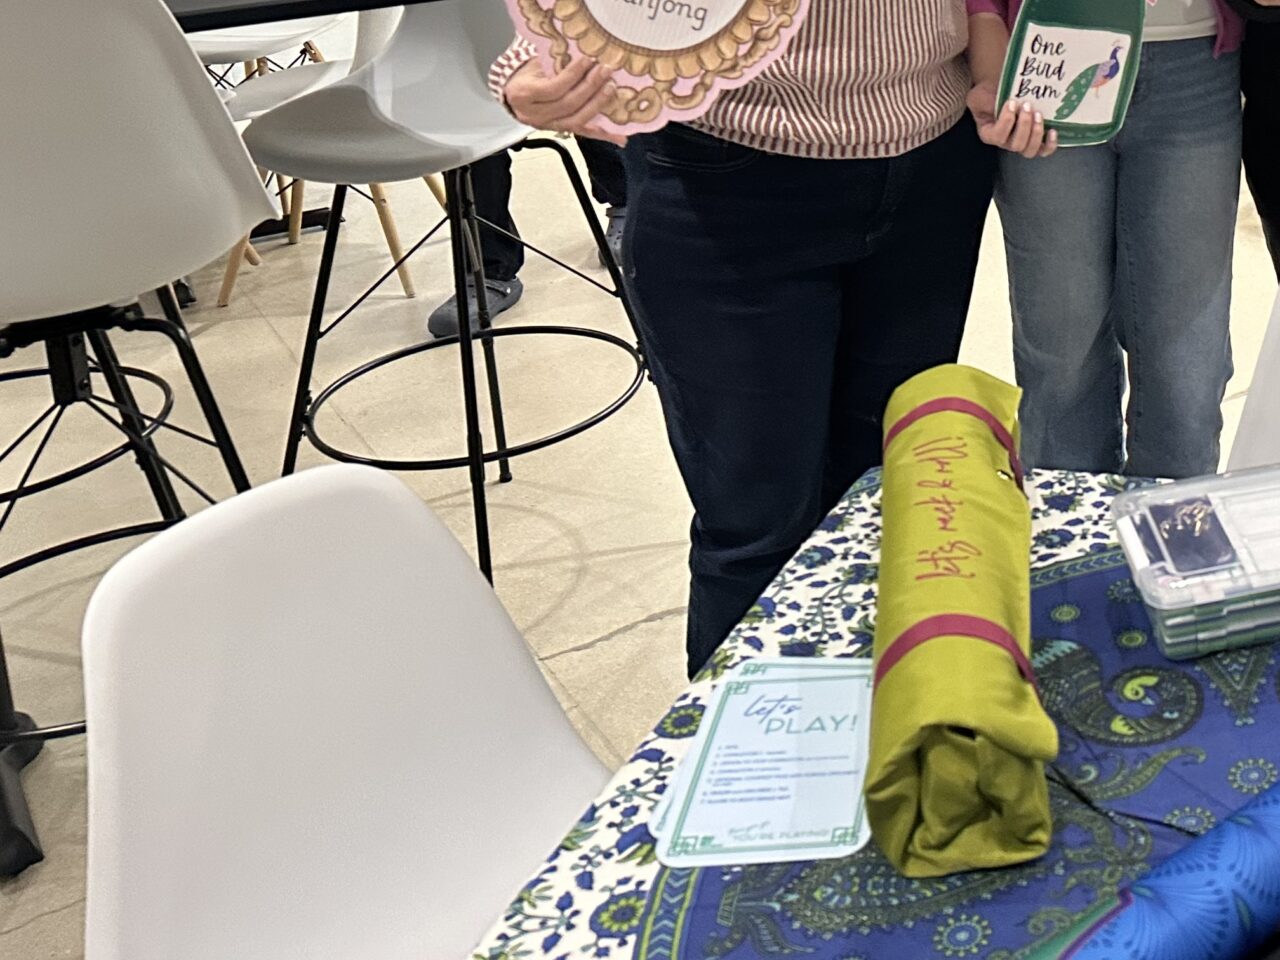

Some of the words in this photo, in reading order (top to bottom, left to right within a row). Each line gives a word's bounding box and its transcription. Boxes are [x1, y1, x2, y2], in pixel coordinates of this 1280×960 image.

[1031, 34, 1066, 56] One
[1019, 56, 1065, 80] Bird
[1015, 78, 1060, 99] Bam
[764, 714, 858, 735] PLAY!
